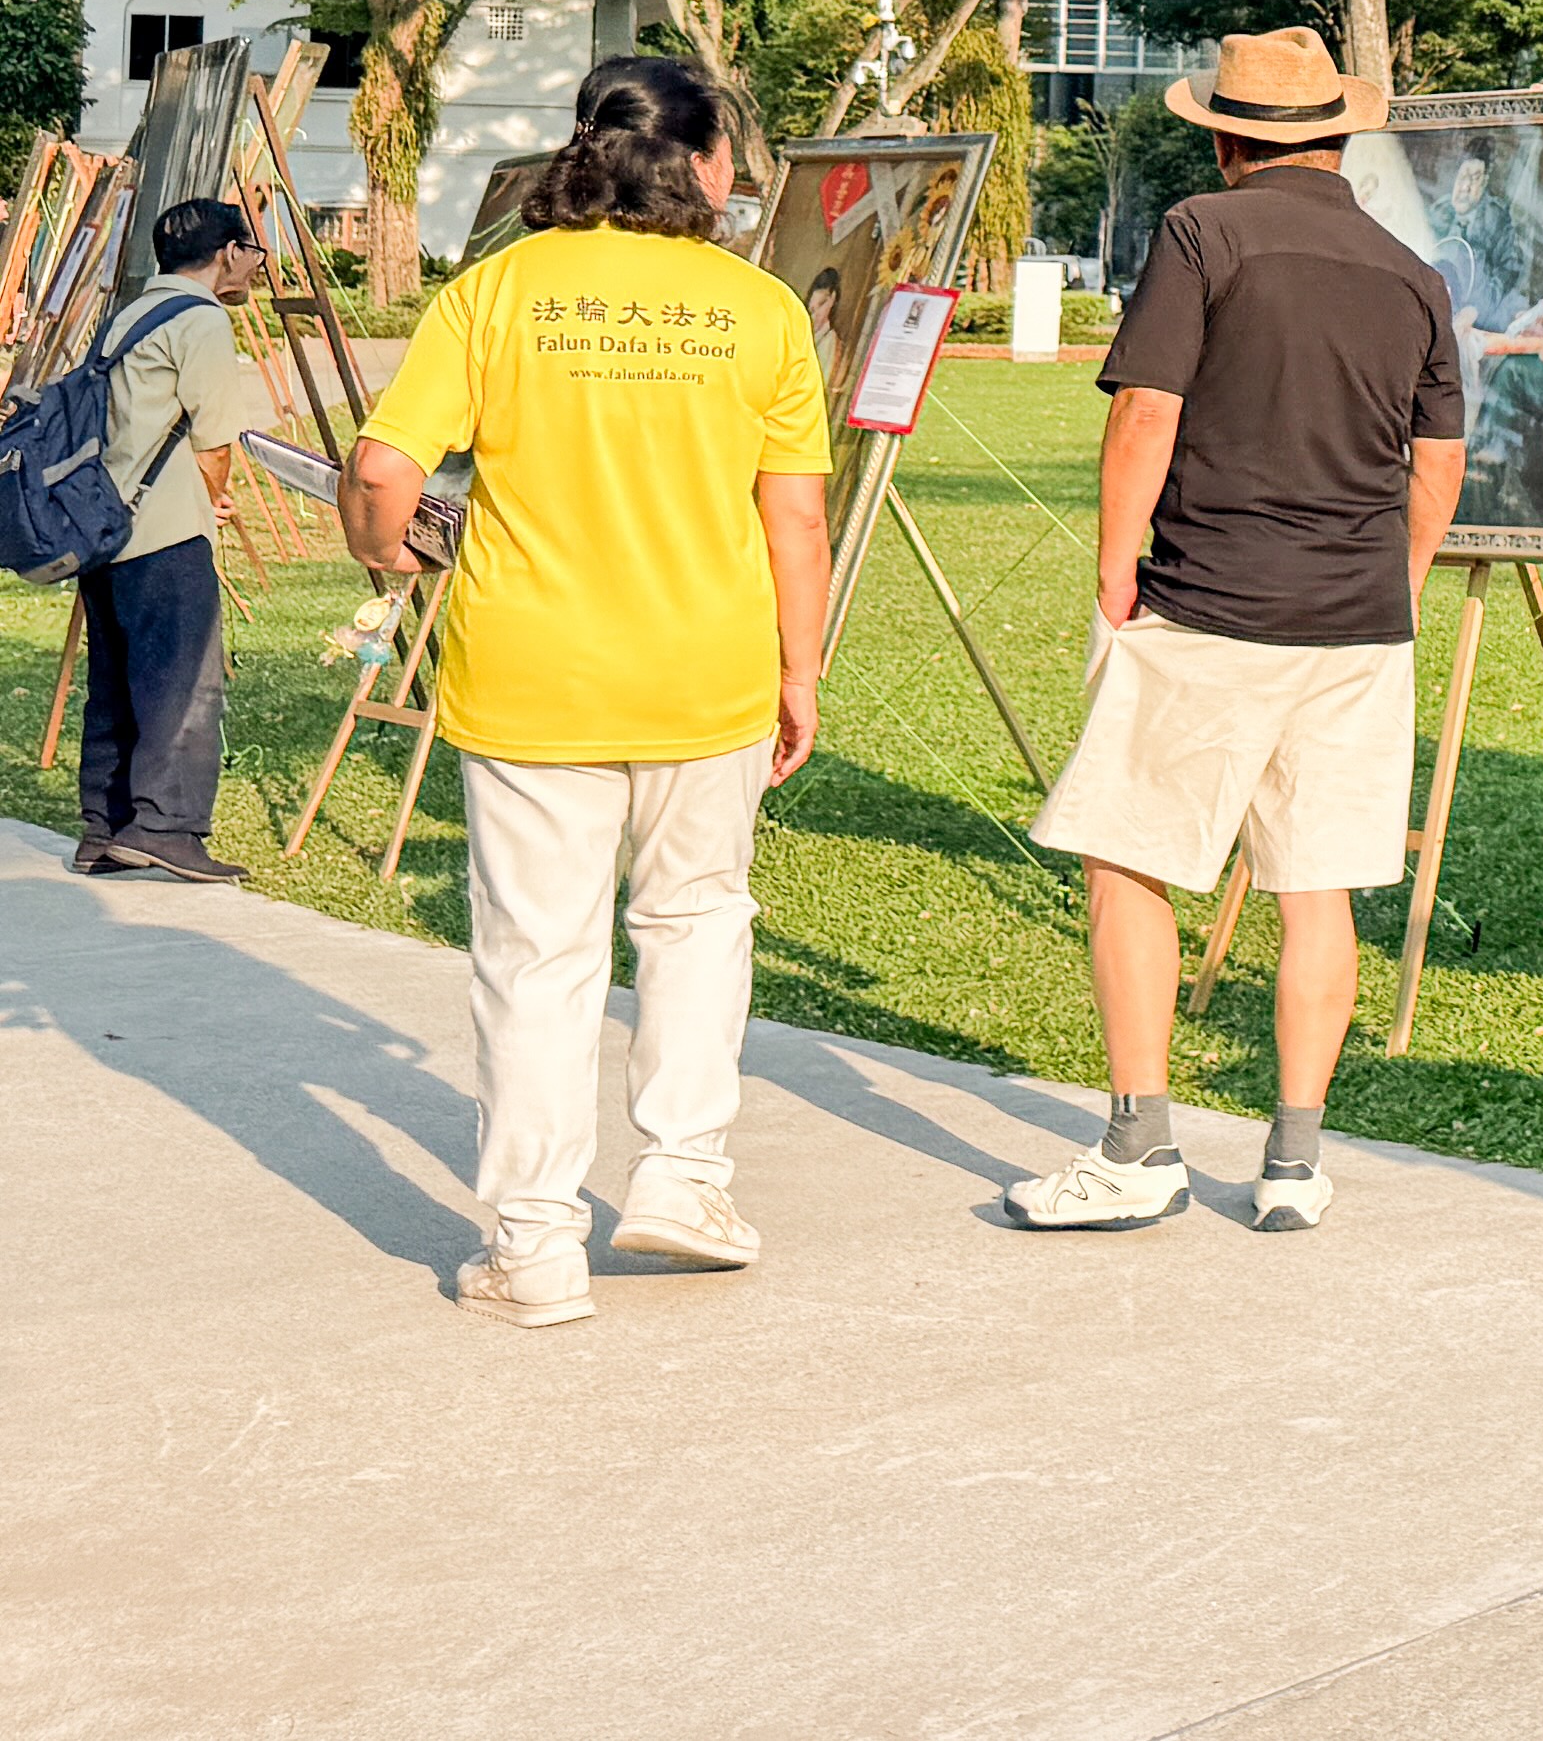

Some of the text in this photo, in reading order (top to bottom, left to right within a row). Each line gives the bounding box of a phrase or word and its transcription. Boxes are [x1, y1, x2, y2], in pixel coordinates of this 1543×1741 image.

[532, 295, 737, 332] 法輪大法好
[537, 333, 736, 359] Falun Dafa is Good
[569, 368, 705, 385] www.falundafa.org
